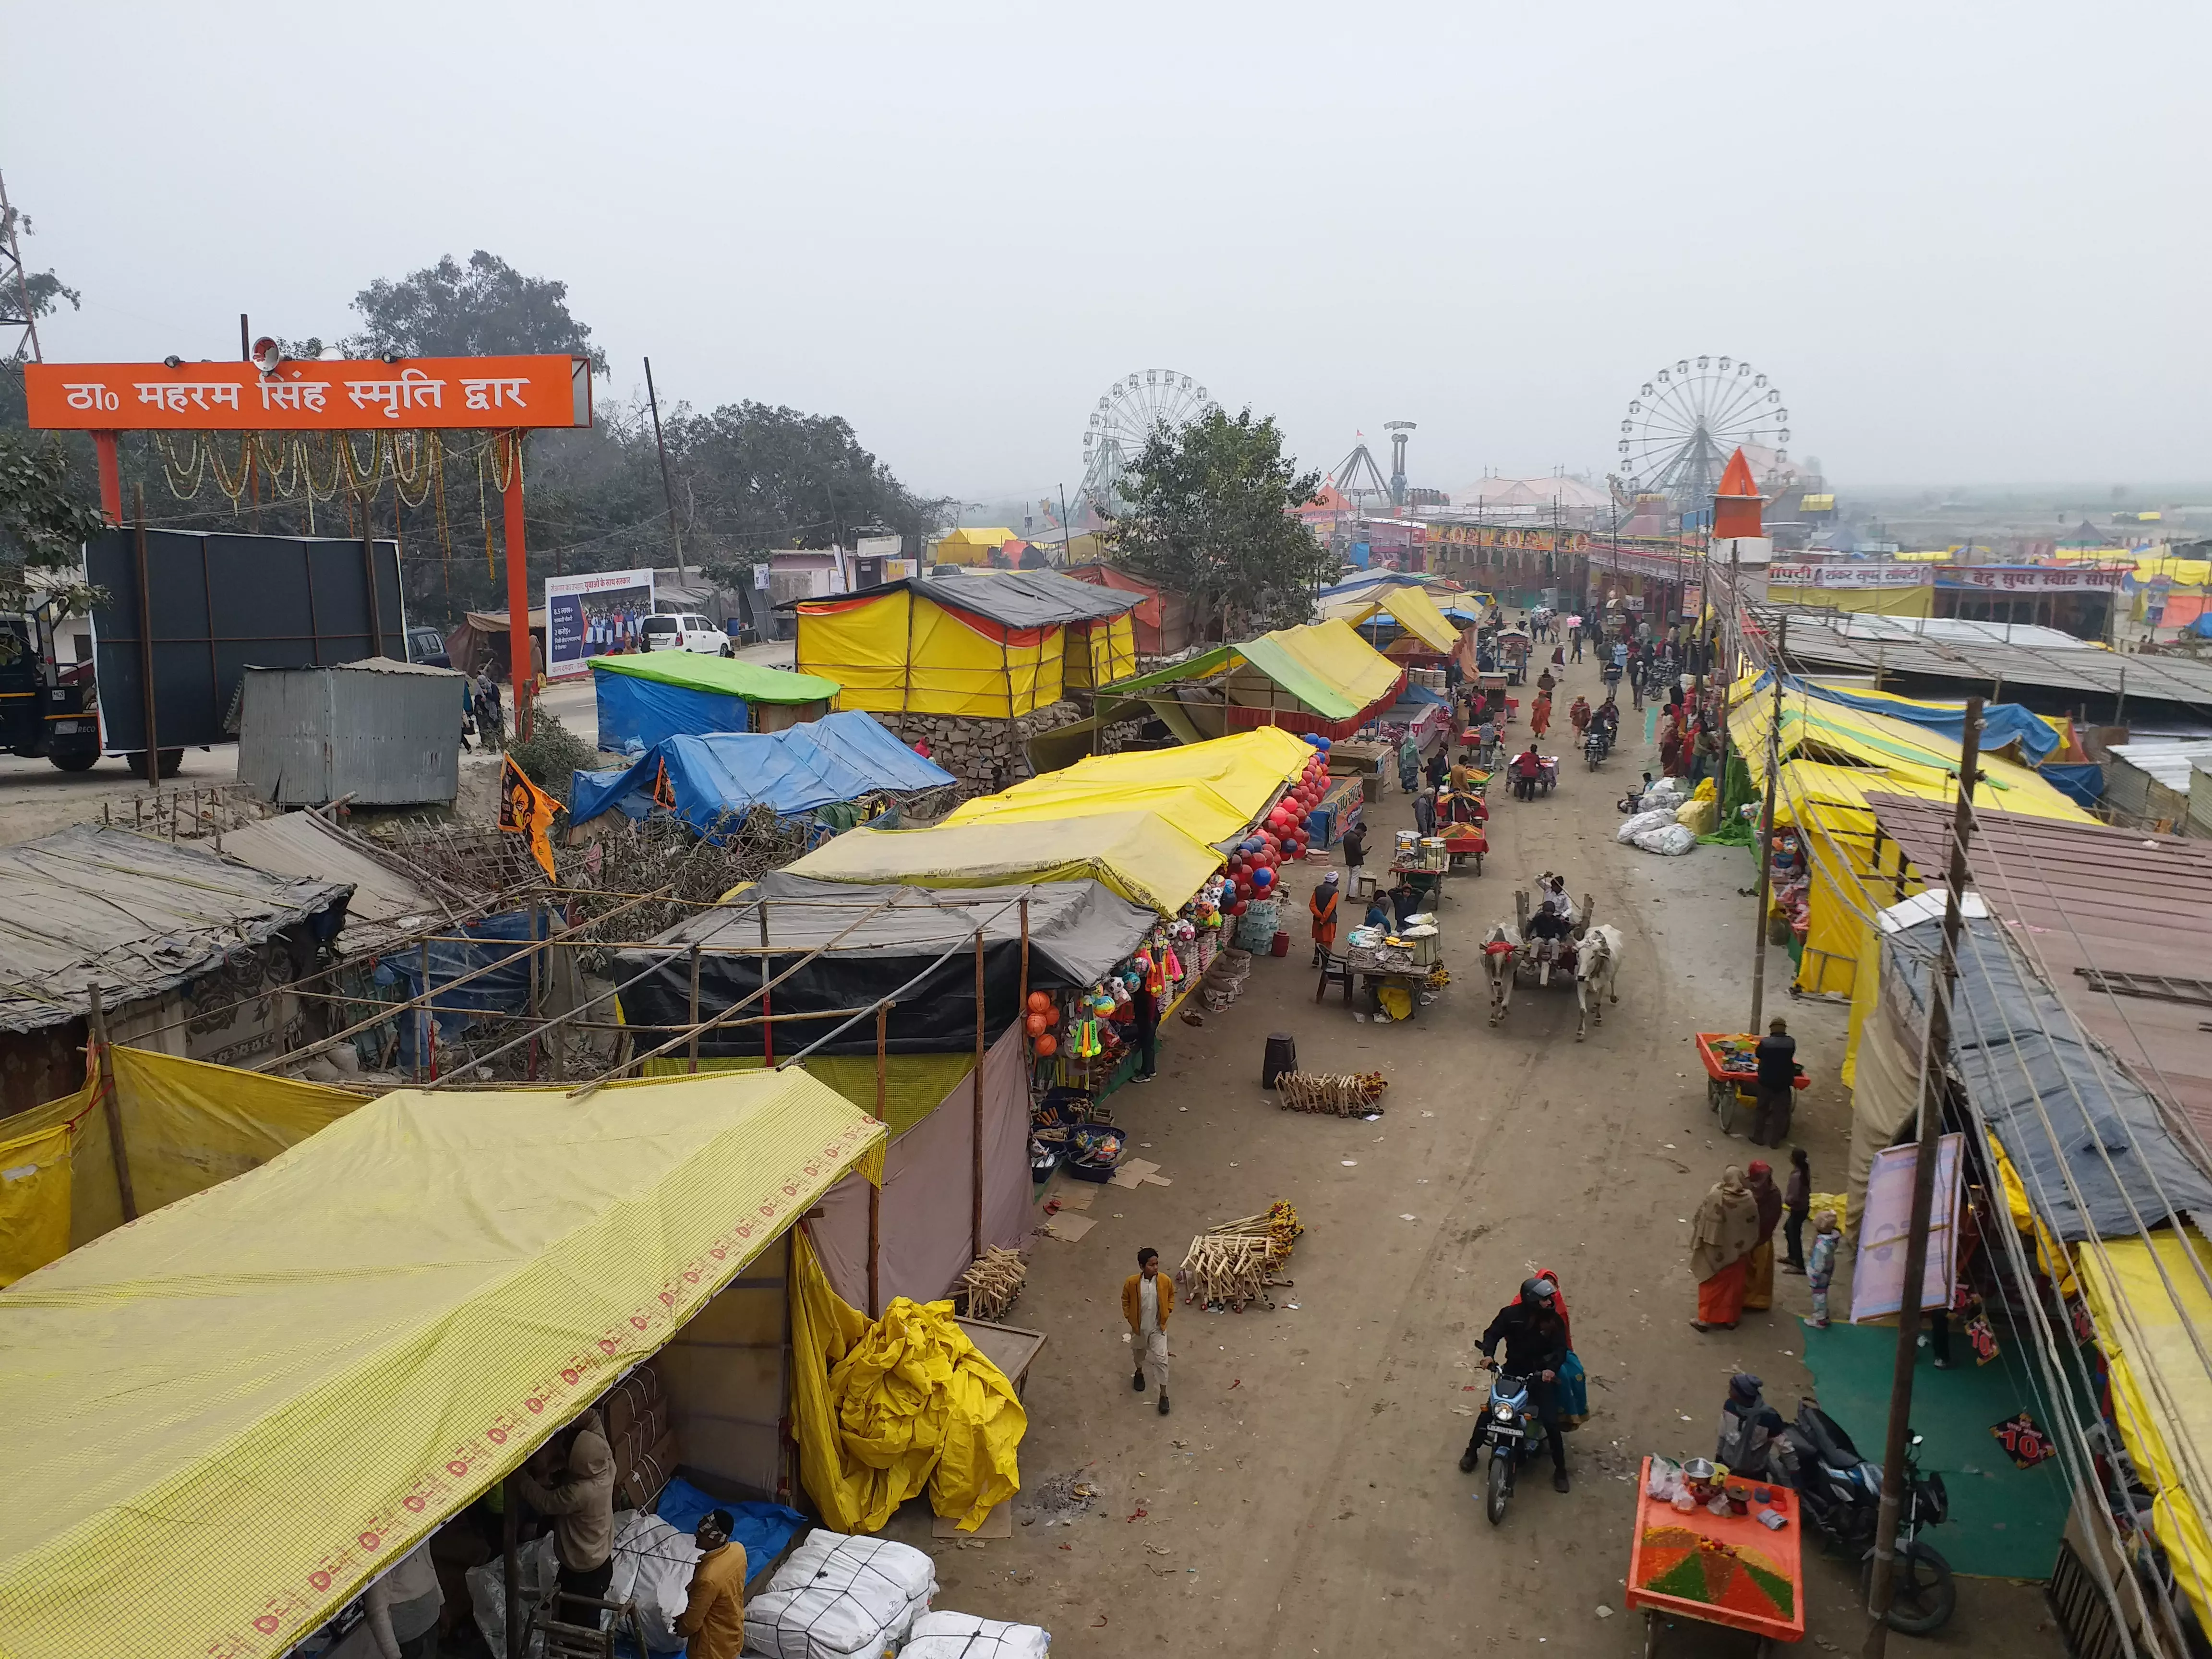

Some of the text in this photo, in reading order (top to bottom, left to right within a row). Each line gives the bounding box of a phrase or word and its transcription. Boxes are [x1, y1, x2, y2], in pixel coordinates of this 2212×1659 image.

[133, 383, 242, 413] महरम
[255, 371, 331, 412] सिंह
[344, 369, 446, 418] स्मृति
[459, 378, 530, 409] द्वार
[584, 577, 600, 592] युवाओं
[600, 577, 605, 587] के
[616, 577, 631, 586] सरकार
[1970, 1329, 1990, 1356] 10
[2001, 1429, 2040, 1458] 10
